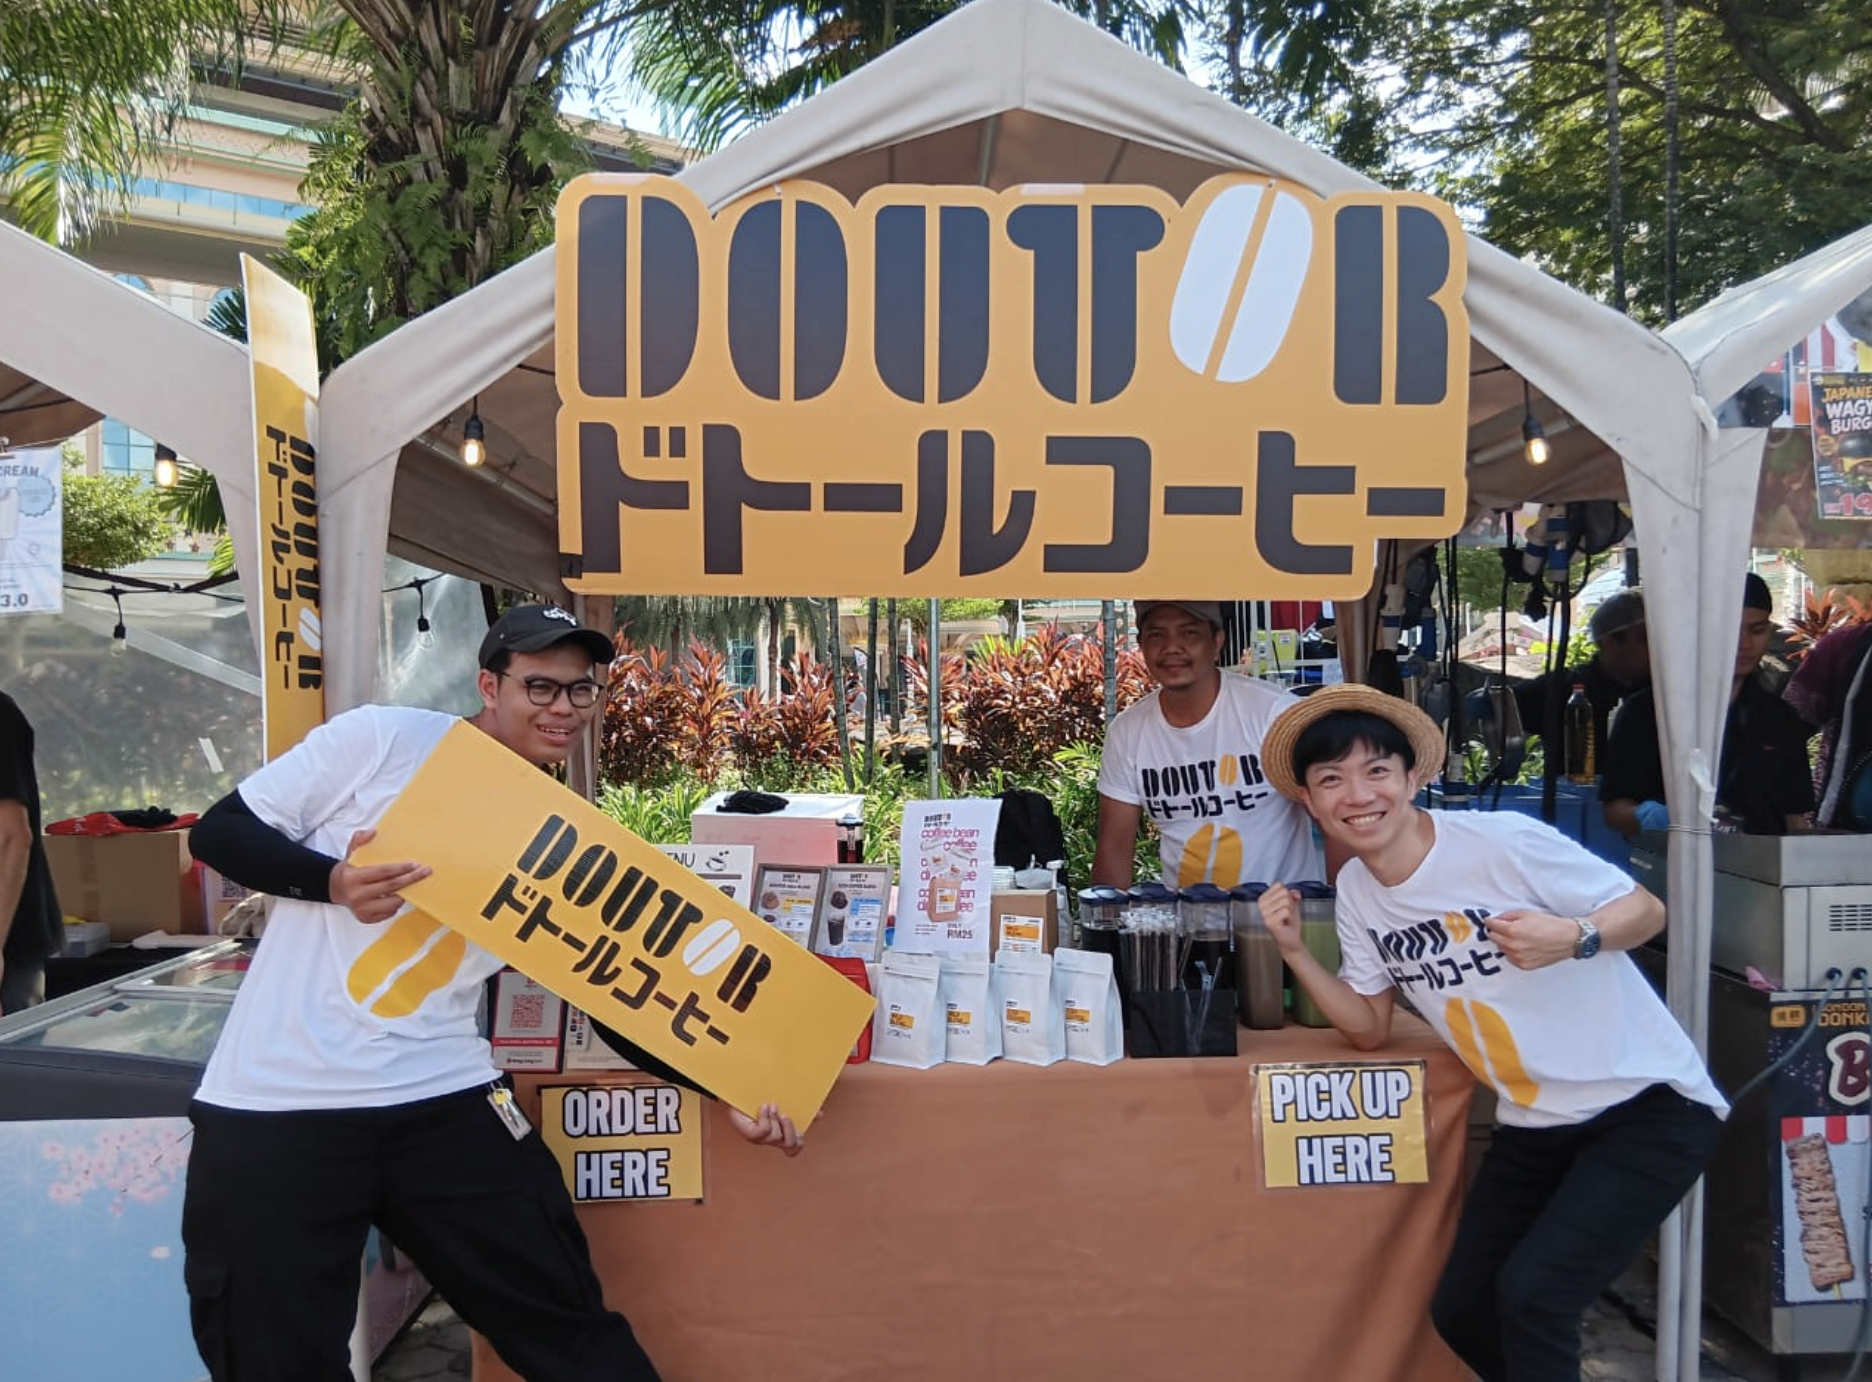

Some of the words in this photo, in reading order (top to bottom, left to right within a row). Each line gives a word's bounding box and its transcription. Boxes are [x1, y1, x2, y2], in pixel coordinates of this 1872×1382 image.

[577, 184, 1450, 405] DOUTOR
[579, 420, 1446, 577] ドトールコーヒー
[266, 425, 295, 690] ドトールコーヒー
[1141, 753, 1264, 798] DOUTOR
[1146, 790, 1268, 819] ドトールコーヒー
[666, 852, 696, 868] NU
[516, 813, 772, 1013] DOUTOR
[480, 872, 730, 1047] ドトールコーヒー
[563, 1086, 681, 1137] ORDER
[1270, 1070, 1359, 1123] PICK
[1360, 1069, 1412, 1119] UP
[575, 1148, 670, 1200] HERE
[1296, 1133, 1395, 1185] HERE
